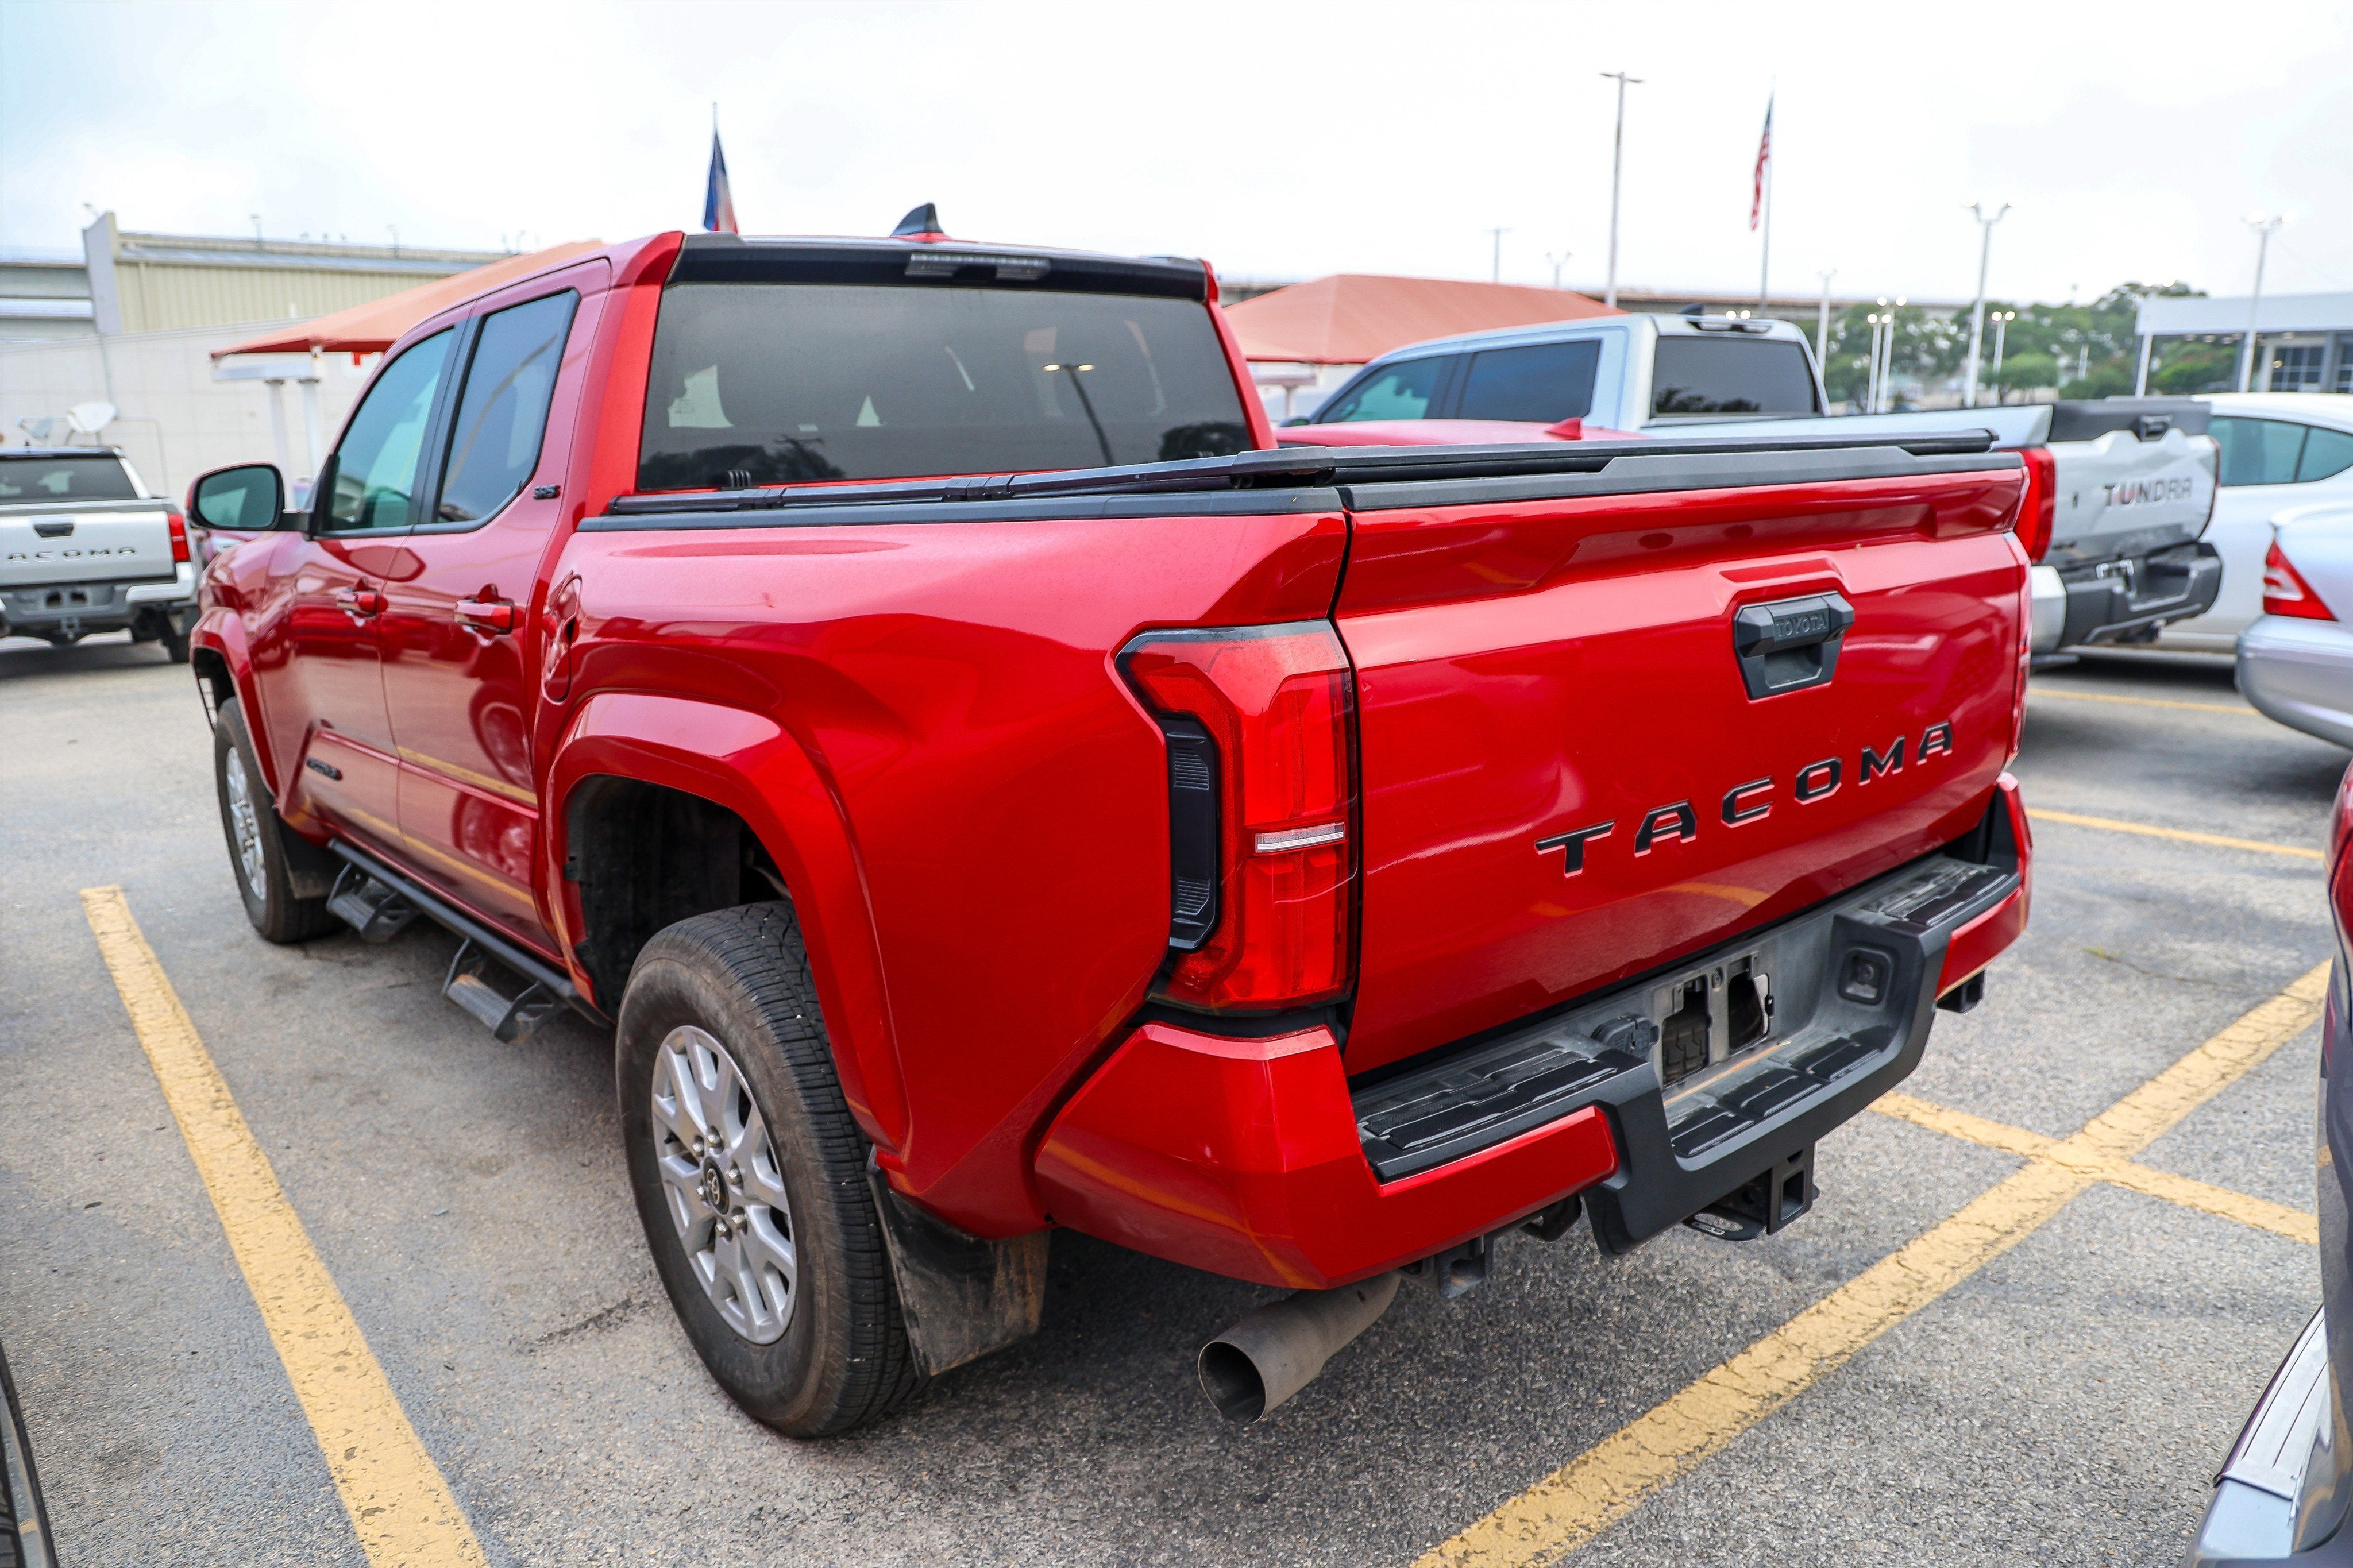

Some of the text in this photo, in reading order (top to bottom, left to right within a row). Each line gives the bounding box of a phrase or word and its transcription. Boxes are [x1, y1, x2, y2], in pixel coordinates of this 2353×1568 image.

[2103, 477, 2192, 508] TUNDRA
[1775, 613, 1827, 637] TOYOTA
[1534, 720, 1953, 878] TACOMA
